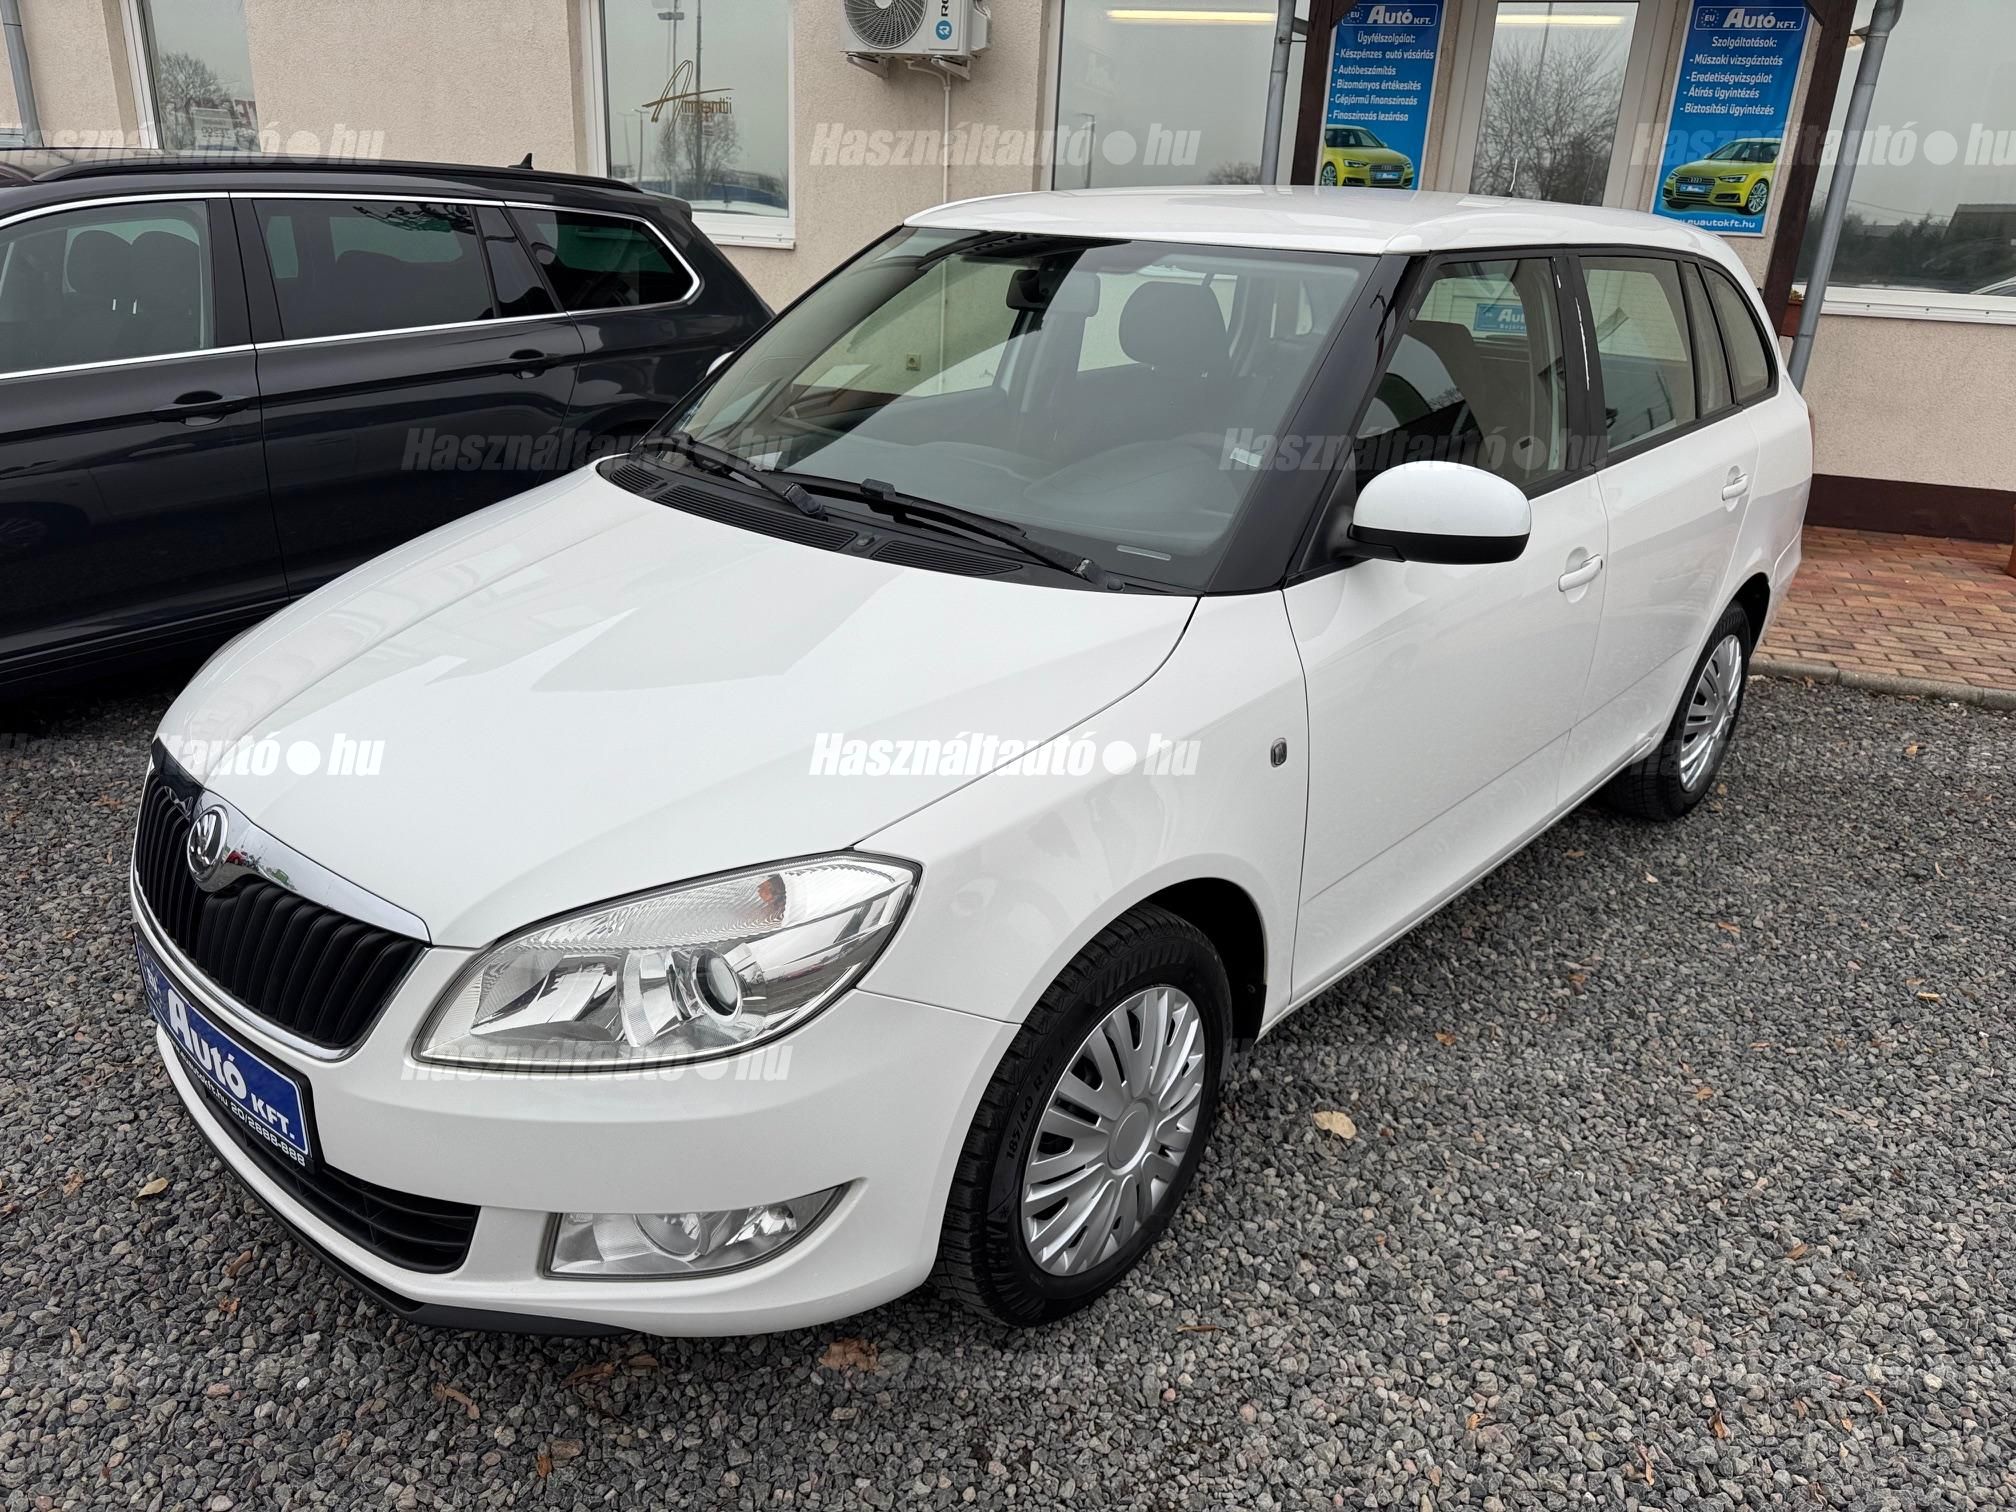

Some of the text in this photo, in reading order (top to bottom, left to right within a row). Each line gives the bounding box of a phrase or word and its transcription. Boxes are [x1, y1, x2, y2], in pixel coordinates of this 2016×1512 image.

[1366, 5, 1413, 24] Autó
[1413, 17, 1431, 25] KFT.
[1722, 8, 1776, 28] Autó
[1776, 21, 1797, 29] KFT.
[1711, 36, 1777, 49] Szolgáltatások:
[1385, 49, 1402, 58] autó
[168, 988, 247, 1100] Autó
[250, 1092, 295, 1140] KFT.
